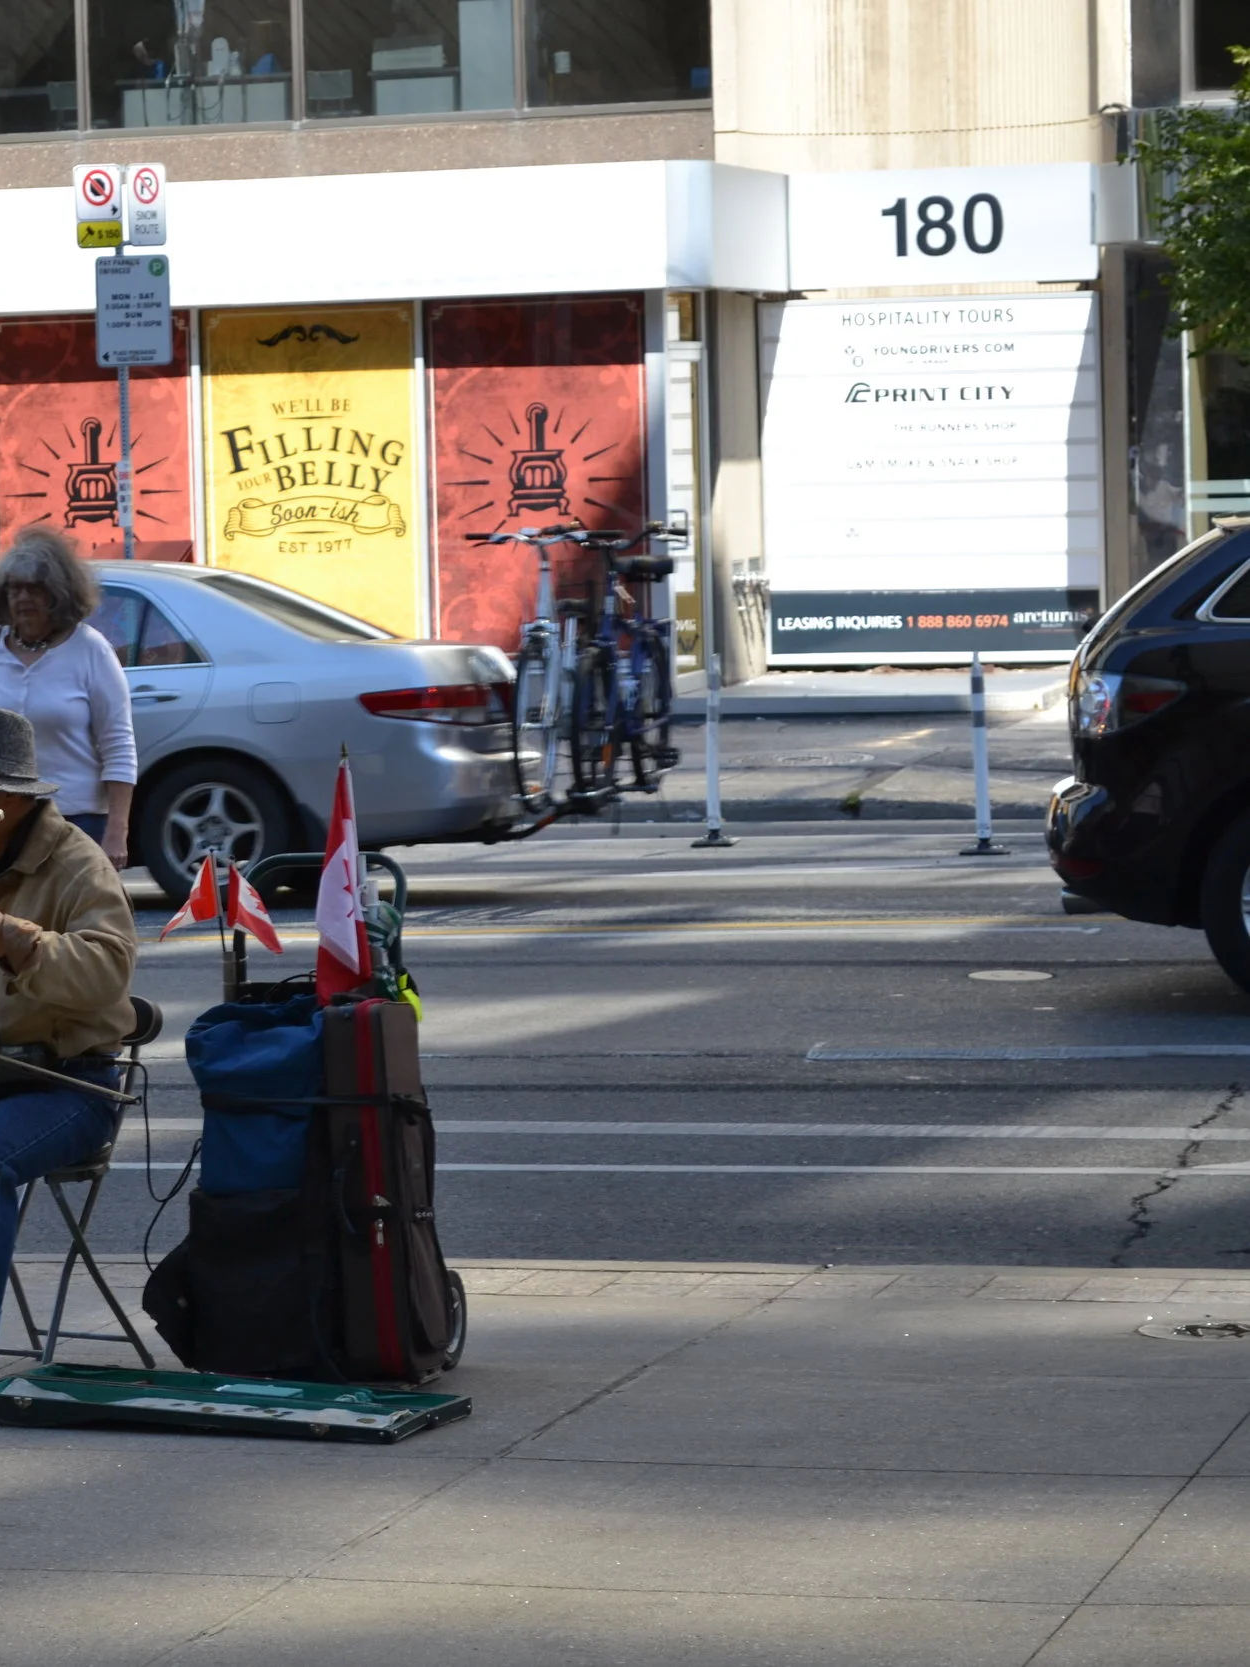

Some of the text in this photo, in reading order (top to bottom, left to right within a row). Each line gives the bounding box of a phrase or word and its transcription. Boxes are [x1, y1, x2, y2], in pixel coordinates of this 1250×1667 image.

[136, 210, 158, 221] SNOW
[134, 223, 160, 235] ROUTE
[882, 193, 1004, 257] 180
[111, 293, 131, 301] MON
[125, 311, 143, 319] SUN
[842, 308, 1015, 326] HOSPITALITY TOURS
[874, 385, 1014, 402] PRINT CITY
[272, 398, 351, 416] WE'LL BE
[220, 425, 405, 475] FILLING
[236, 460, 393, 493] YOUR BELLY
[270, 501, 360, 525] Soon-ish
[318, 538, 352, 553] 1977
[777, 609, 1088, 631] LEASING INQUIRIES 1 888 860 6974 arcturus
